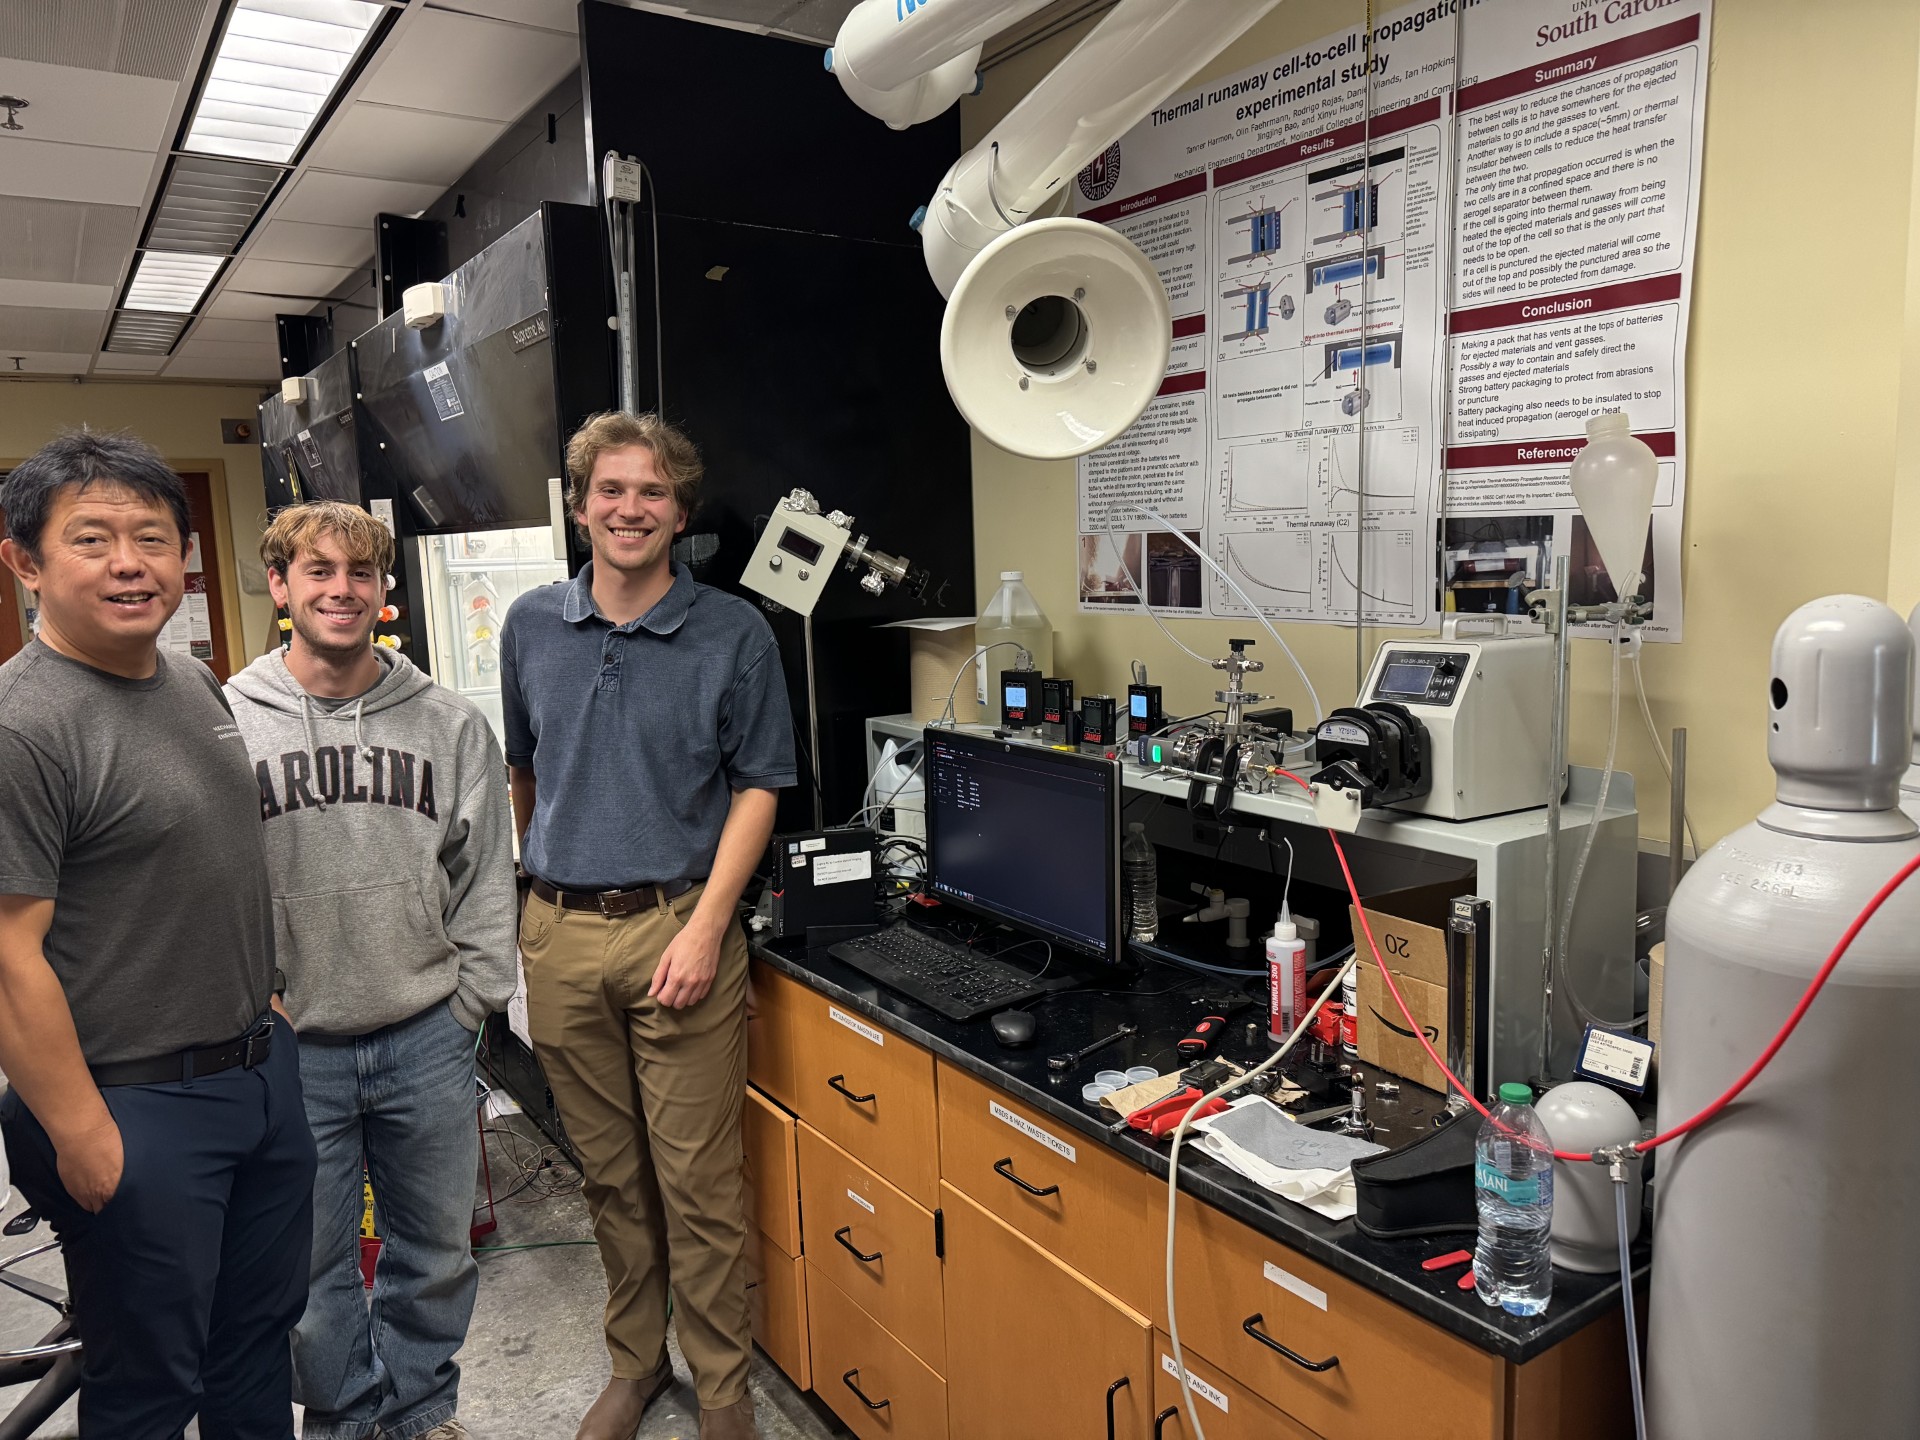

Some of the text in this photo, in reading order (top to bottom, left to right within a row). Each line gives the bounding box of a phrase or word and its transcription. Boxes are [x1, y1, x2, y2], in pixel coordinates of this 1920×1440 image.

[1536, 10, 1598, 47] South
[1151, 93, 1204, 127] Thermal
[1208, 71, 1269, 106] runaway
[1273, 33, 1356, 81] cell-to-cell
[1535, 56, 1597, 83] Summary
[1236, 53, 1390, 121] experimental study
[1369, 97, 1411, 116] ngineering
[1413, 89, 1429, 102] and
[1431, 74, 1479, 96] Comuting
[1468, 59, 1678, 127] The best way to reduce the chances of propagation
[1207, 133, 1234, 147] Harmon,
[1250, 114, 1291, 132] Faehrmann,
[1293, 103, 1320, 118] Rodrigo
[1321, 95, 1345, 108] Rojas,
[1373, 74, 1402, 90] Viands,
[1405, 69, 1419, 80] Ian
[1421, 56, 1455, 74] Hopkins
[1468, 70, 1677, 139] between cells is to have somewhere for the ejected
[1300, 137, 1335, 156] Results
[1120, 195, 1157, 212] Introduction
[1521, 298, 1592, 318] Conclusion
[1461, 313, 1664, 350] Making a pack that has vents at the tops of batteries
[1459, 342, 1636, 372] Possibly a way to contain and safely direct the
[1460, 335, 1606, 361] for ejected materials and vent gasses.
[1458, 363, 1570, 385] gasses and ejected materials
[1458, 365, 1654, 394] Strong battery packaging to protect from abrasions
[1457, 395, 1499, 406] or puncture
[1457, 389, 1662, 417] Battery packaging also needs to be insulated to stop
[1457, 405, 1621, 428] heat induced propagation (aerogel or heat
[1294, 428, 1313, 437] thermal
[1315, 427, 1339, 435] runaway
[1457, 427, 1500, 439] dissipating)
[1517, 446, 1584, 460] Reference
[256, 745, 438, 823] AROLINA
[1384, 933, 1410, 959] 20
[995, 1106, 1009, 1119] MSDS
[1026, 1124, 1046, 1142] WASTE
[1047, 1136, 1070, 1156] TICKETS
[1476, 1169, 1508, 1192] ASANI
[1168, 1362, 1221, 1404] PAR AND INK
